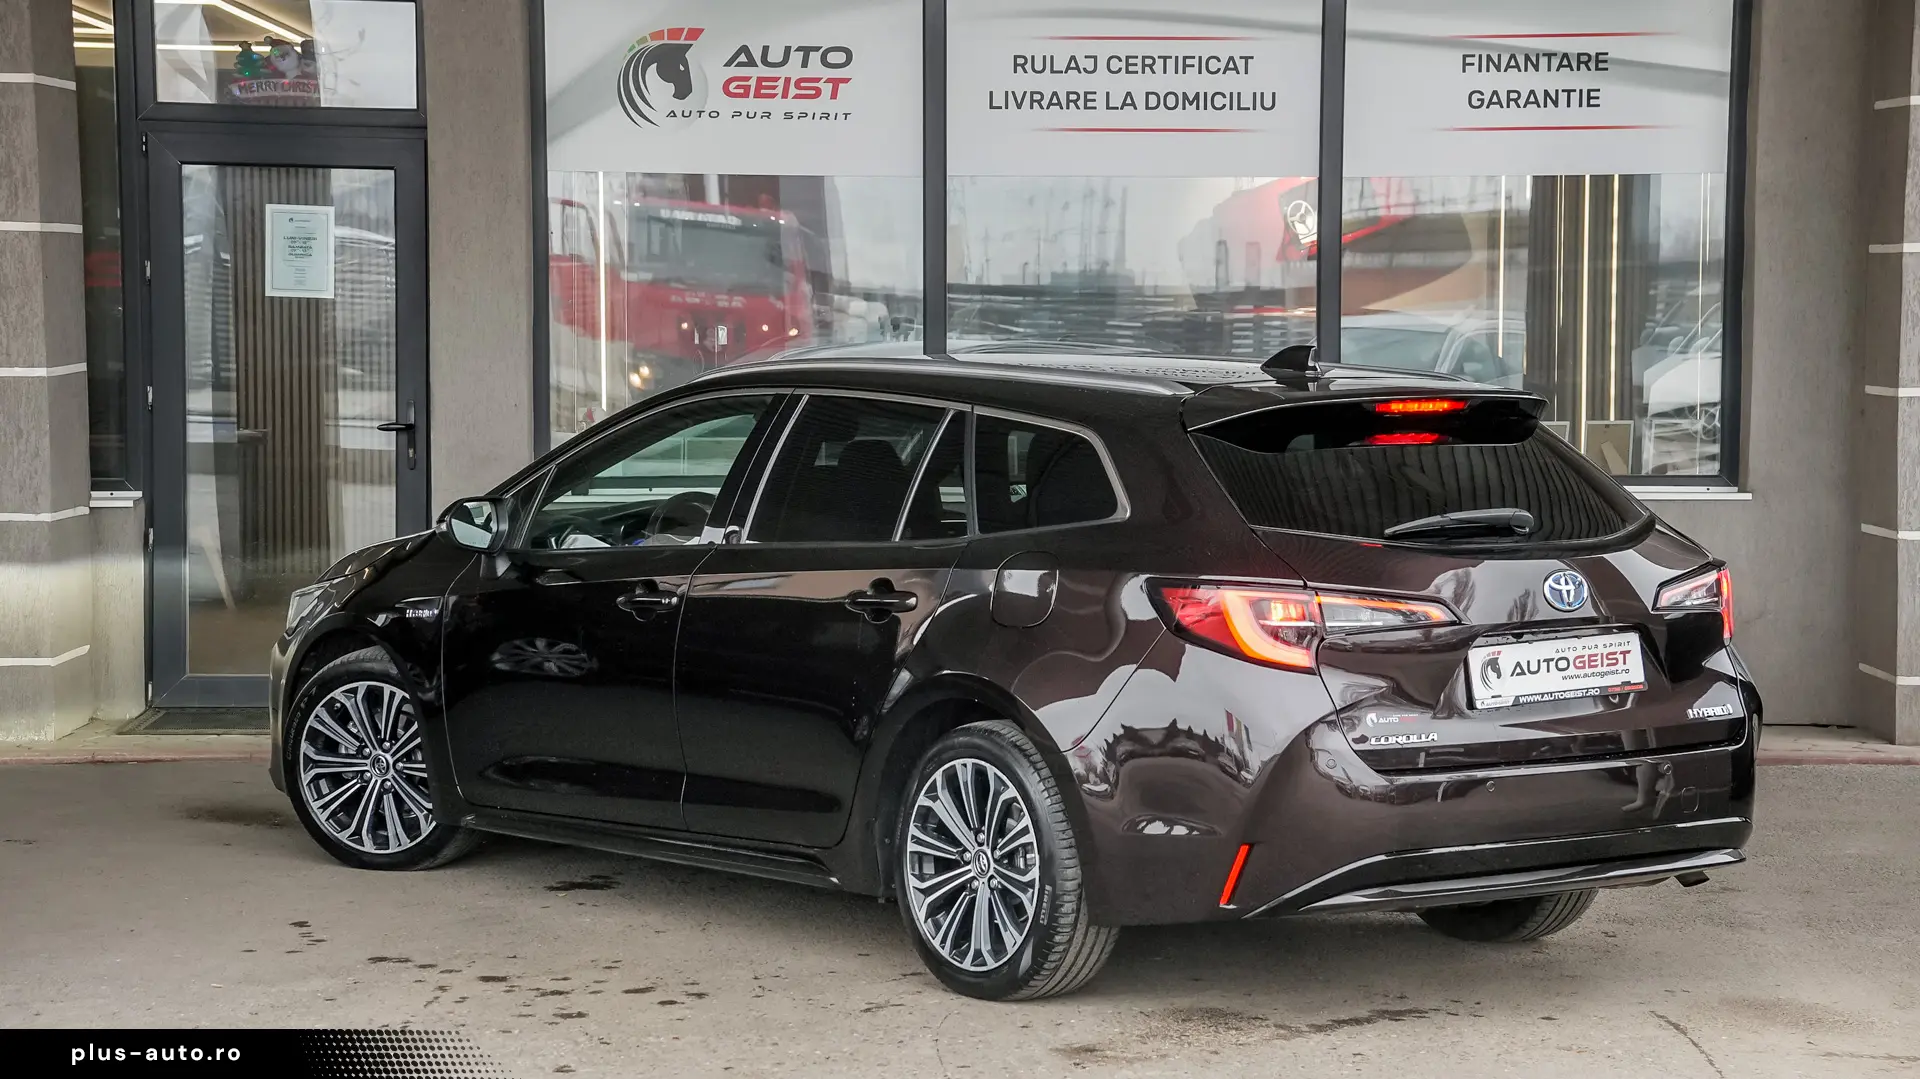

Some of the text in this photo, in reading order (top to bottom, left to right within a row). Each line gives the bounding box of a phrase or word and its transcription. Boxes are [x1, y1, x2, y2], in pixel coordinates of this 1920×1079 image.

[722, 44, 853, 69] AUTO
[1013, 54, 1254, 75] RULAJ CERTIFICAT
[1461, 52, 1609, 73] FINANTARE
[722, 76, 852, 100] GEIST
[988, 90, 1276, 111] LIVRARE LA DOMICILIU
[1467, 88, 1601, 110] GARANTIE
[666, 109, 852, 121] AUTO PUR SPIRIT
[1554, 646, 1578, 654] AUTO
[1603, 640, 1631, 648] SPIRIT
[1561, 668, 1630, 681] www.autogeist.ro
[1519, 688, 1600, 703] WWW.AUTOGEIST.RO
[1687, 705, 1728, 719] HYBRID
[1370, 732, 1438, 745] COROLLA
